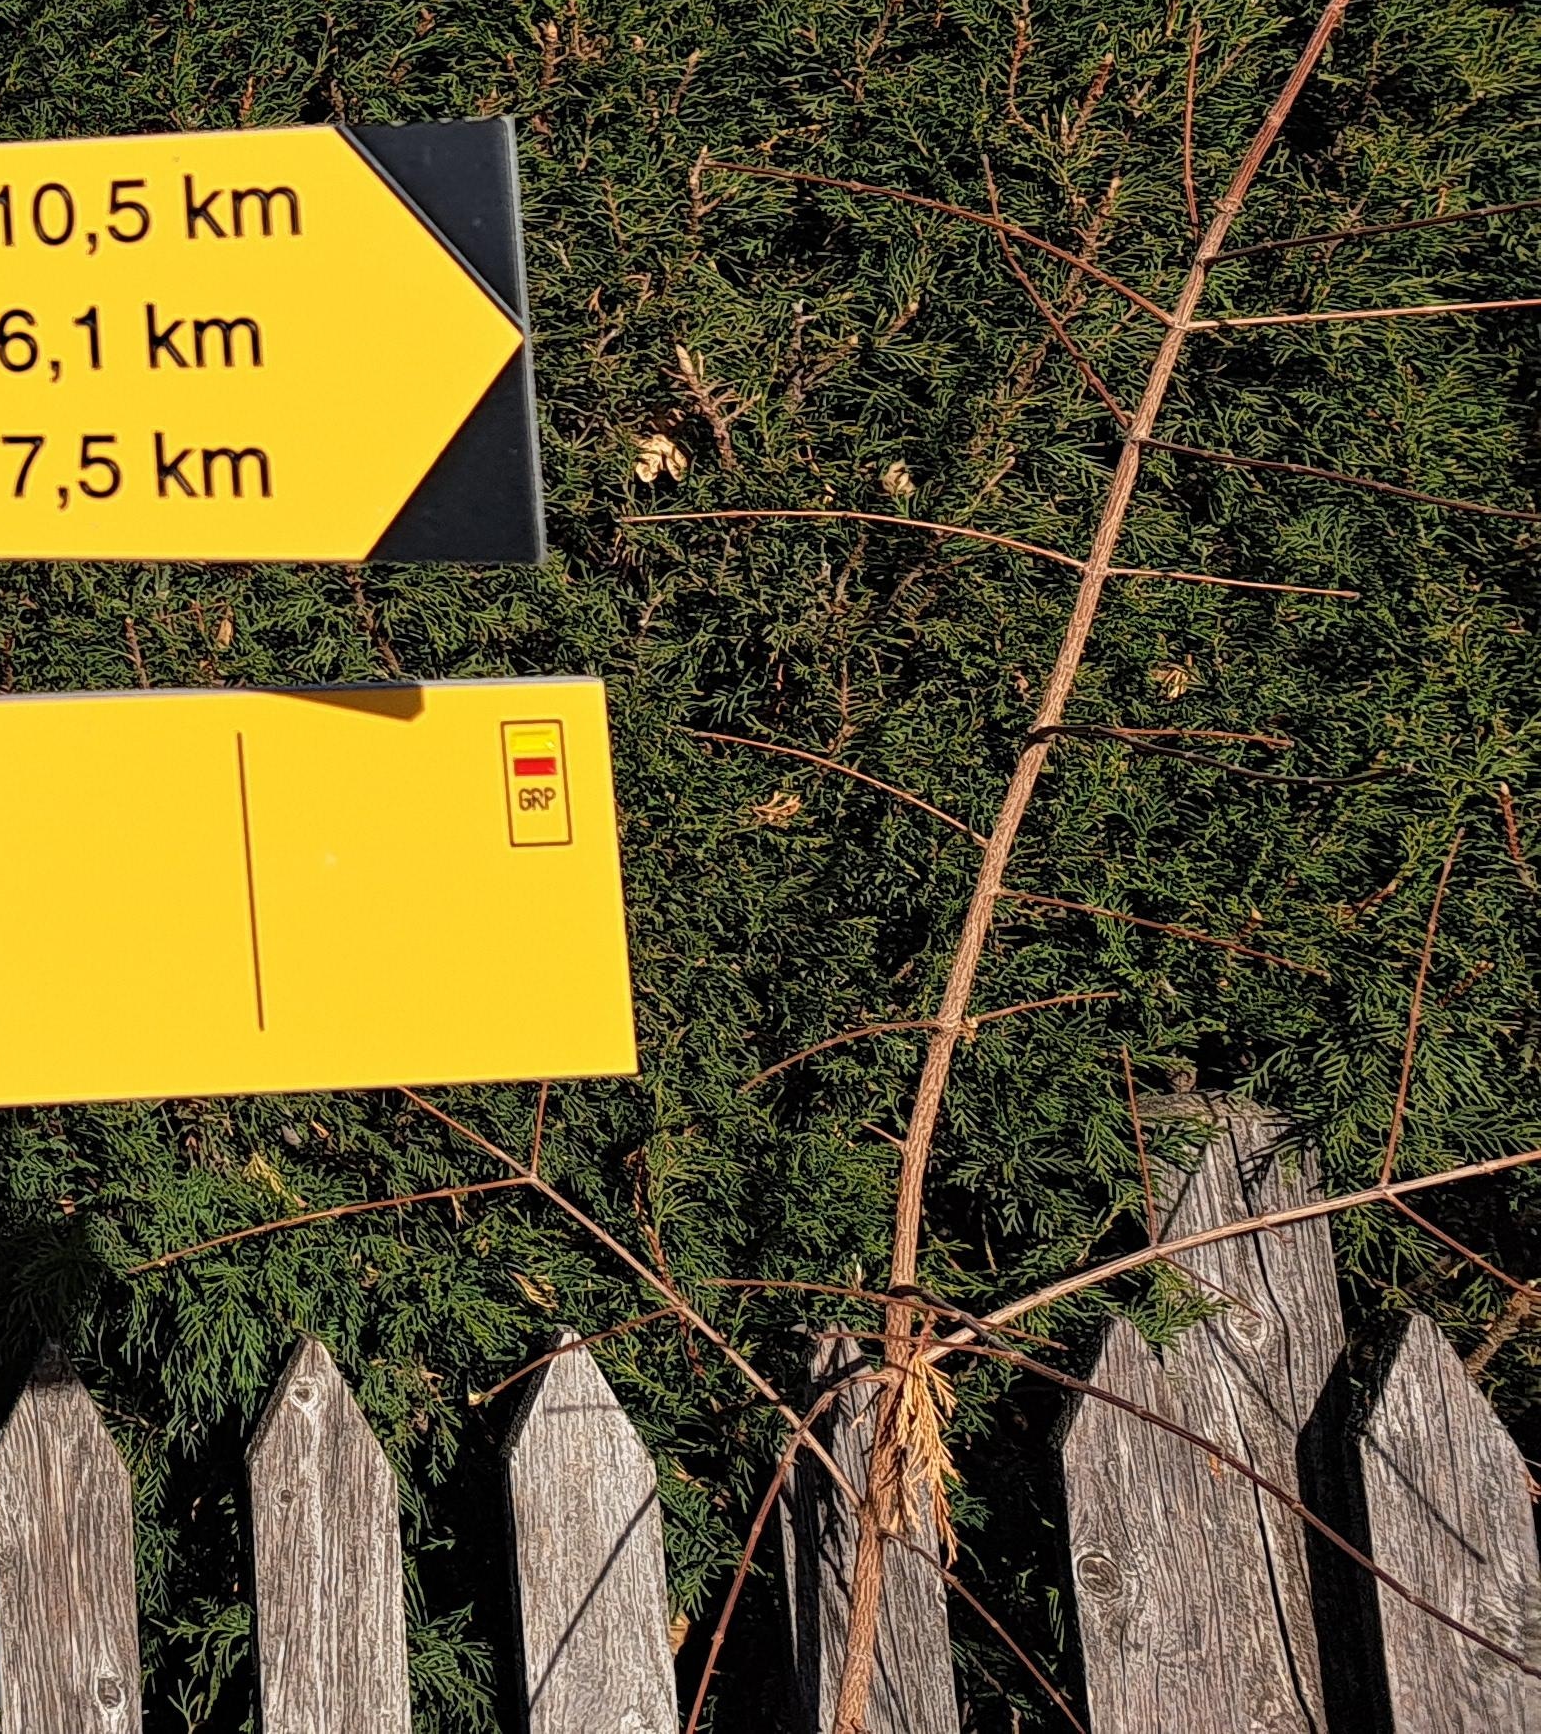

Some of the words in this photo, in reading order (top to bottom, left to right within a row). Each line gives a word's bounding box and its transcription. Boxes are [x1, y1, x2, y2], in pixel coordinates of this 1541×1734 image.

[184, 173, 302, 240] km
[146, 302, 264, 369] km
[1, 434, 121, 511] 7,5
[154, 432, 272, 498] km
[518, 786, 557, 811] GRP
